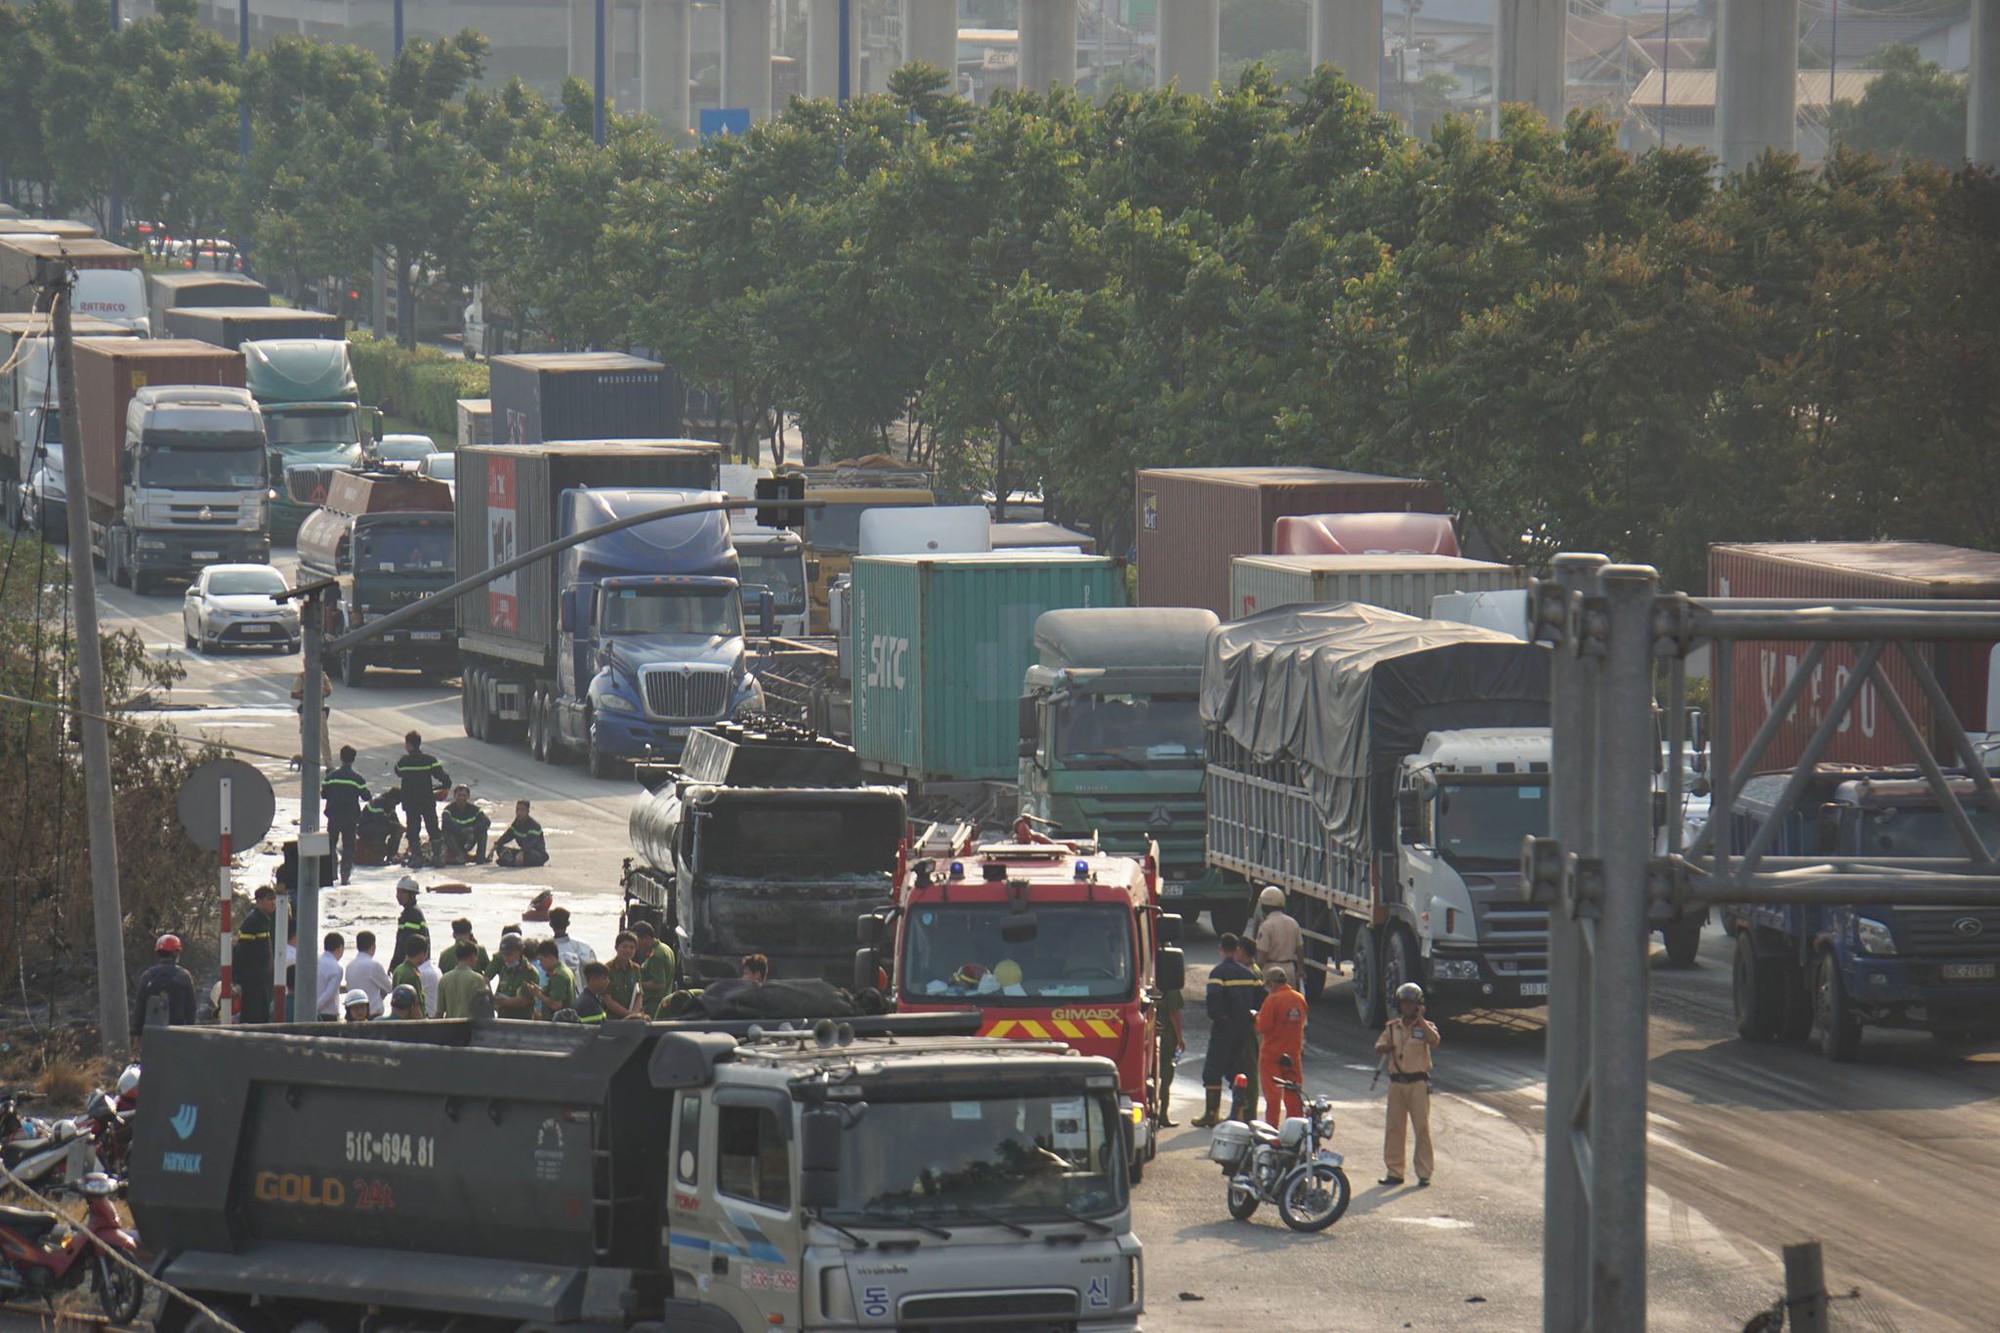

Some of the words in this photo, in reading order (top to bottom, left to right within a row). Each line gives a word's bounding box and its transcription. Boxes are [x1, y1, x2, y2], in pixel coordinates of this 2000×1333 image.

[80, 302, 126, 312] RATRACO
[1052, 1008, 1120, 1021] GIMAEX
[346, 1131, 434, 1168] 51C-694.81
[255, 1171, 346, 1207] GOLD
[863, 1286, 890, 1318] 동
[1087, 1277, 1109, 1306] 신
